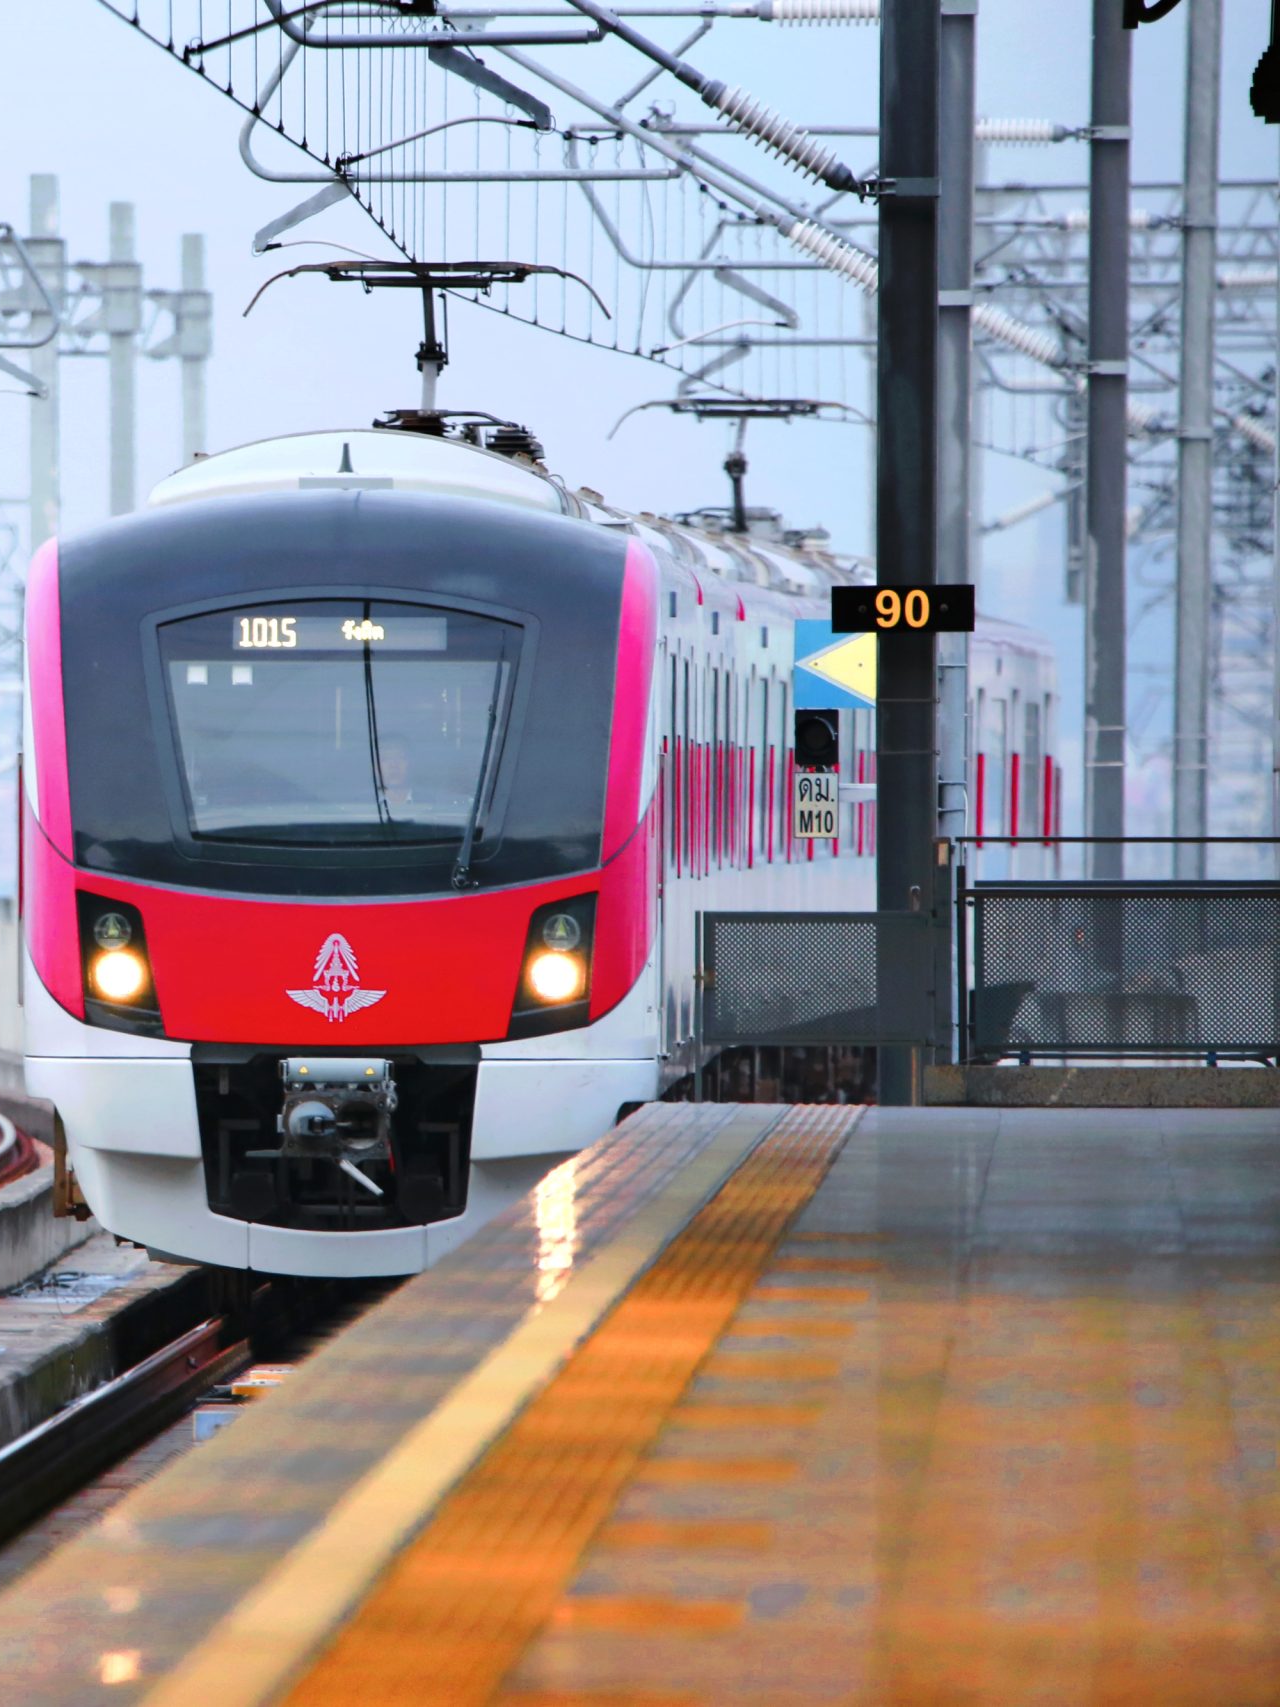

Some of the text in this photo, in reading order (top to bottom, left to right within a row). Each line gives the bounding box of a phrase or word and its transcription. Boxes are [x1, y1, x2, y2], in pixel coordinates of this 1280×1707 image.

[875, 589, 930, 628] 90
[239, 617, 297, 648] 1015
[798, 777, 835, 803] ดม.
[799, 809, 834, 834] M10
